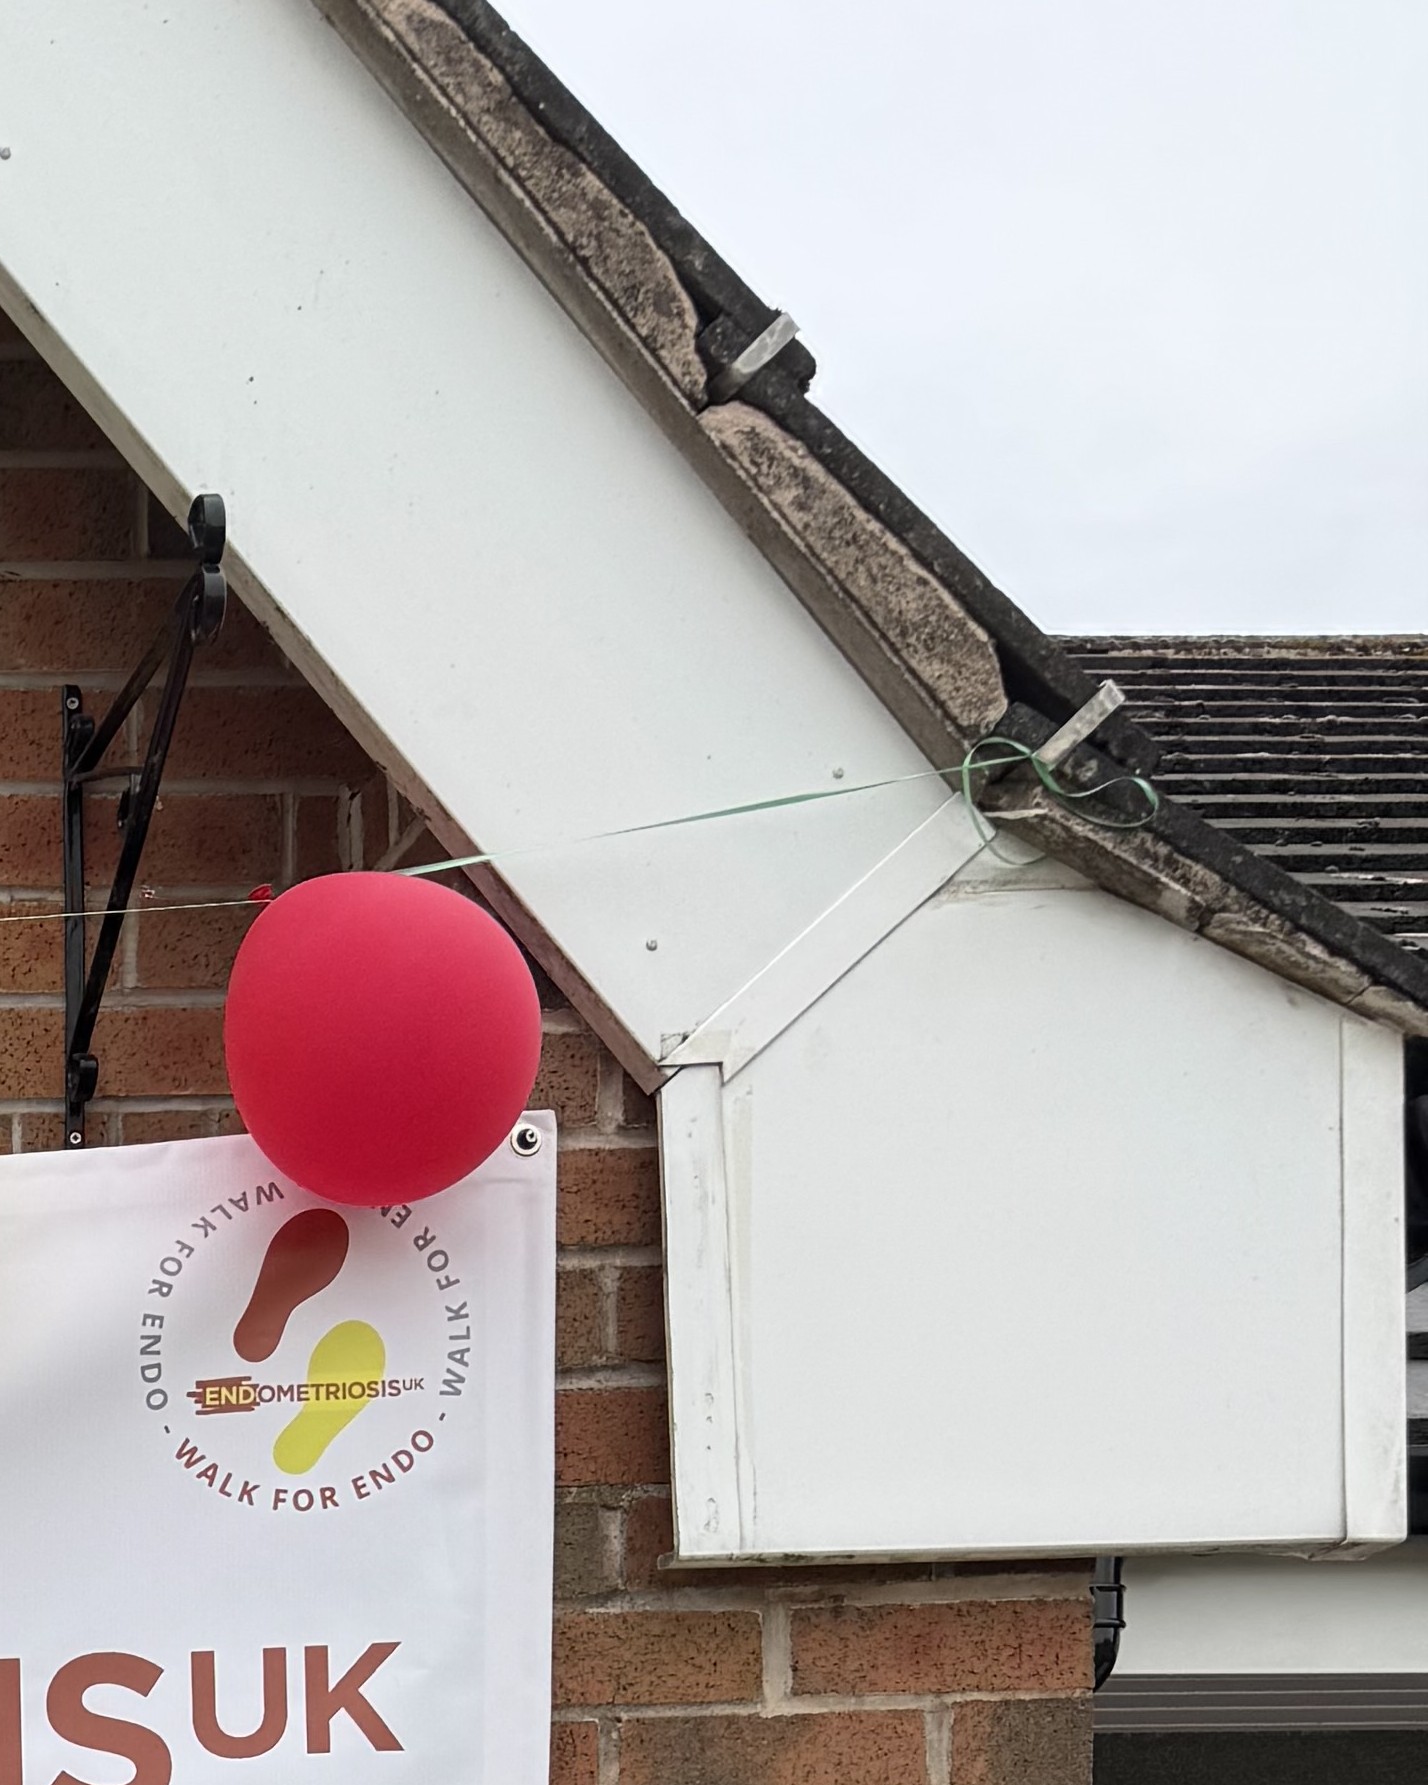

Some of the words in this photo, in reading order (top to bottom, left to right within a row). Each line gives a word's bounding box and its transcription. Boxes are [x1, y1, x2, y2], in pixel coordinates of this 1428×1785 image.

[190, 1181, 285, 1239] WALK
[148, 1239, 195, 1298] FOR
[412, 1226, 461, 1292] FOR
[139, 1313, 169, 1412] ENDO
[439, 1301, 472, 1398] WALK
[174, 1437, 260, 1507] WALK
[271, 1486, 340, 1512] FOR
[351, 1429, 435, 1500] ENDO
